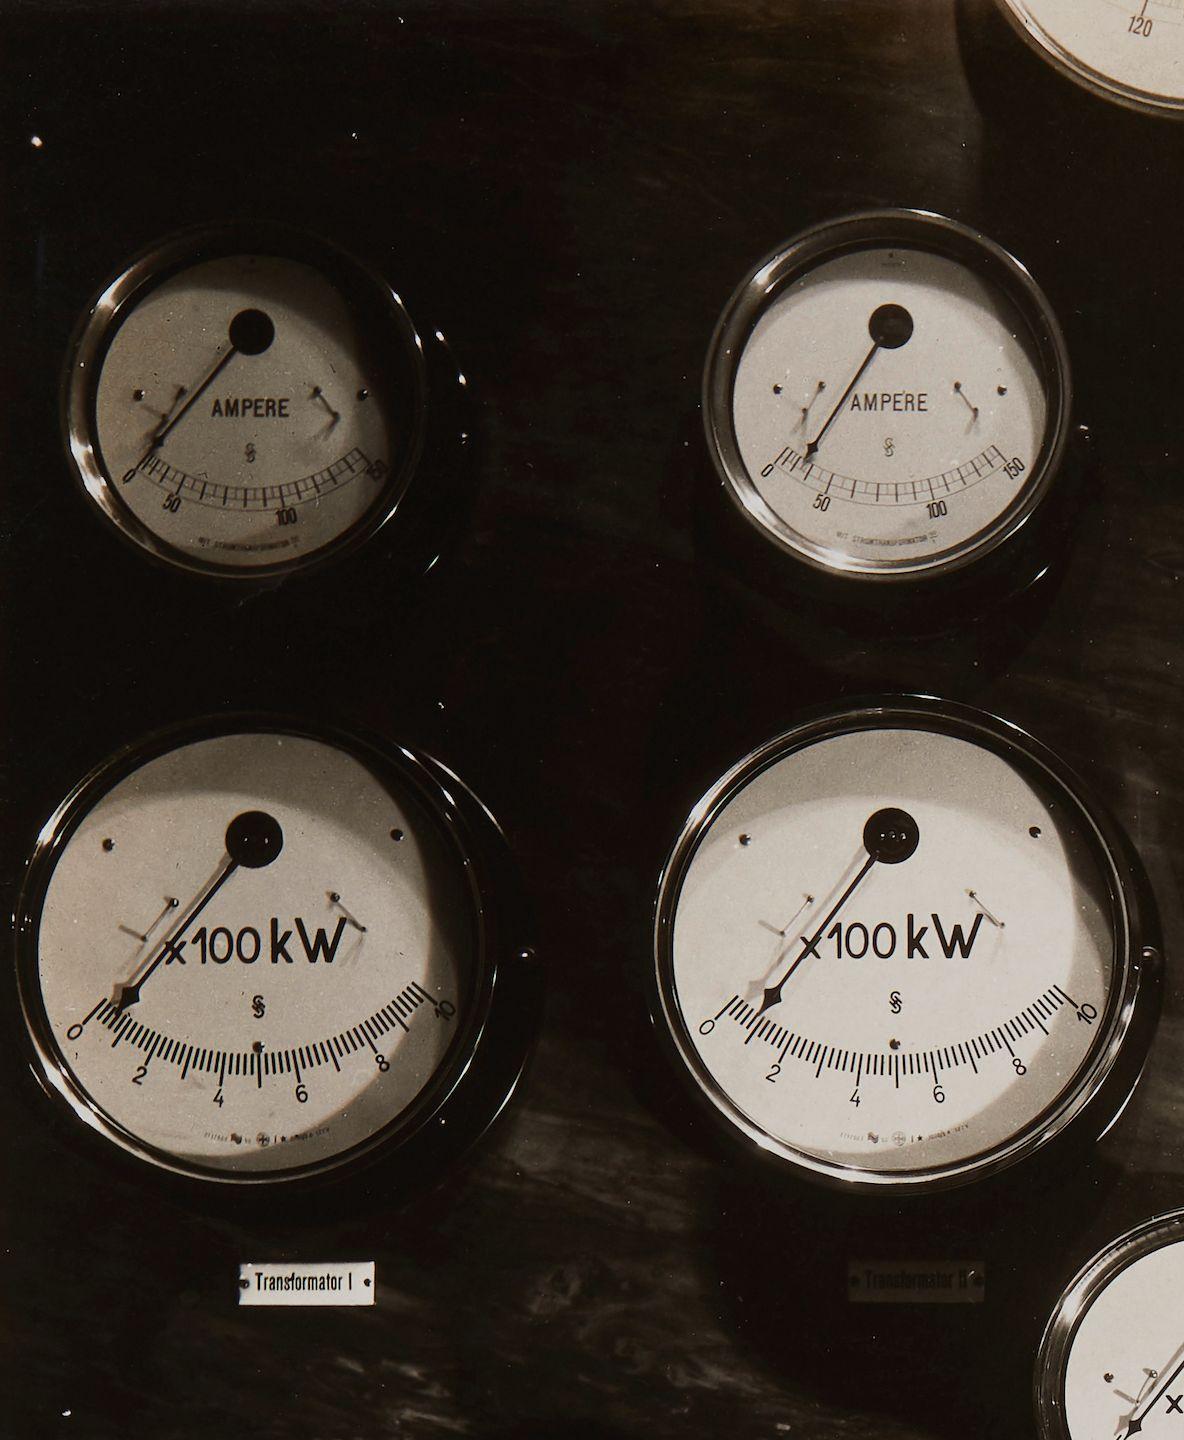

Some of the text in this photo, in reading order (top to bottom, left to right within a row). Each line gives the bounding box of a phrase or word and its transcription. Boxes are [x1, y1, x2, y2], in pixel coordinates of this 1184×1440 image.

[1127, 15, 1152, 38] 120
[211, 399, 289, 418] AMPERE
[850, 393, 929, 412] AMPERE
[122, 468, 136, 484] 0
[162, 495, 182, 512] 50
[275, 507, 297, 526] 100
[761, 457, 1026, 519] 0 50 100 150
[66, 1001, 457, 1107] 0 2 4 6 8 10
[699, 1003, 1098, 1107] 0 2 4 6 8 10
[255, 1271, 353, 1291] Transformator I
